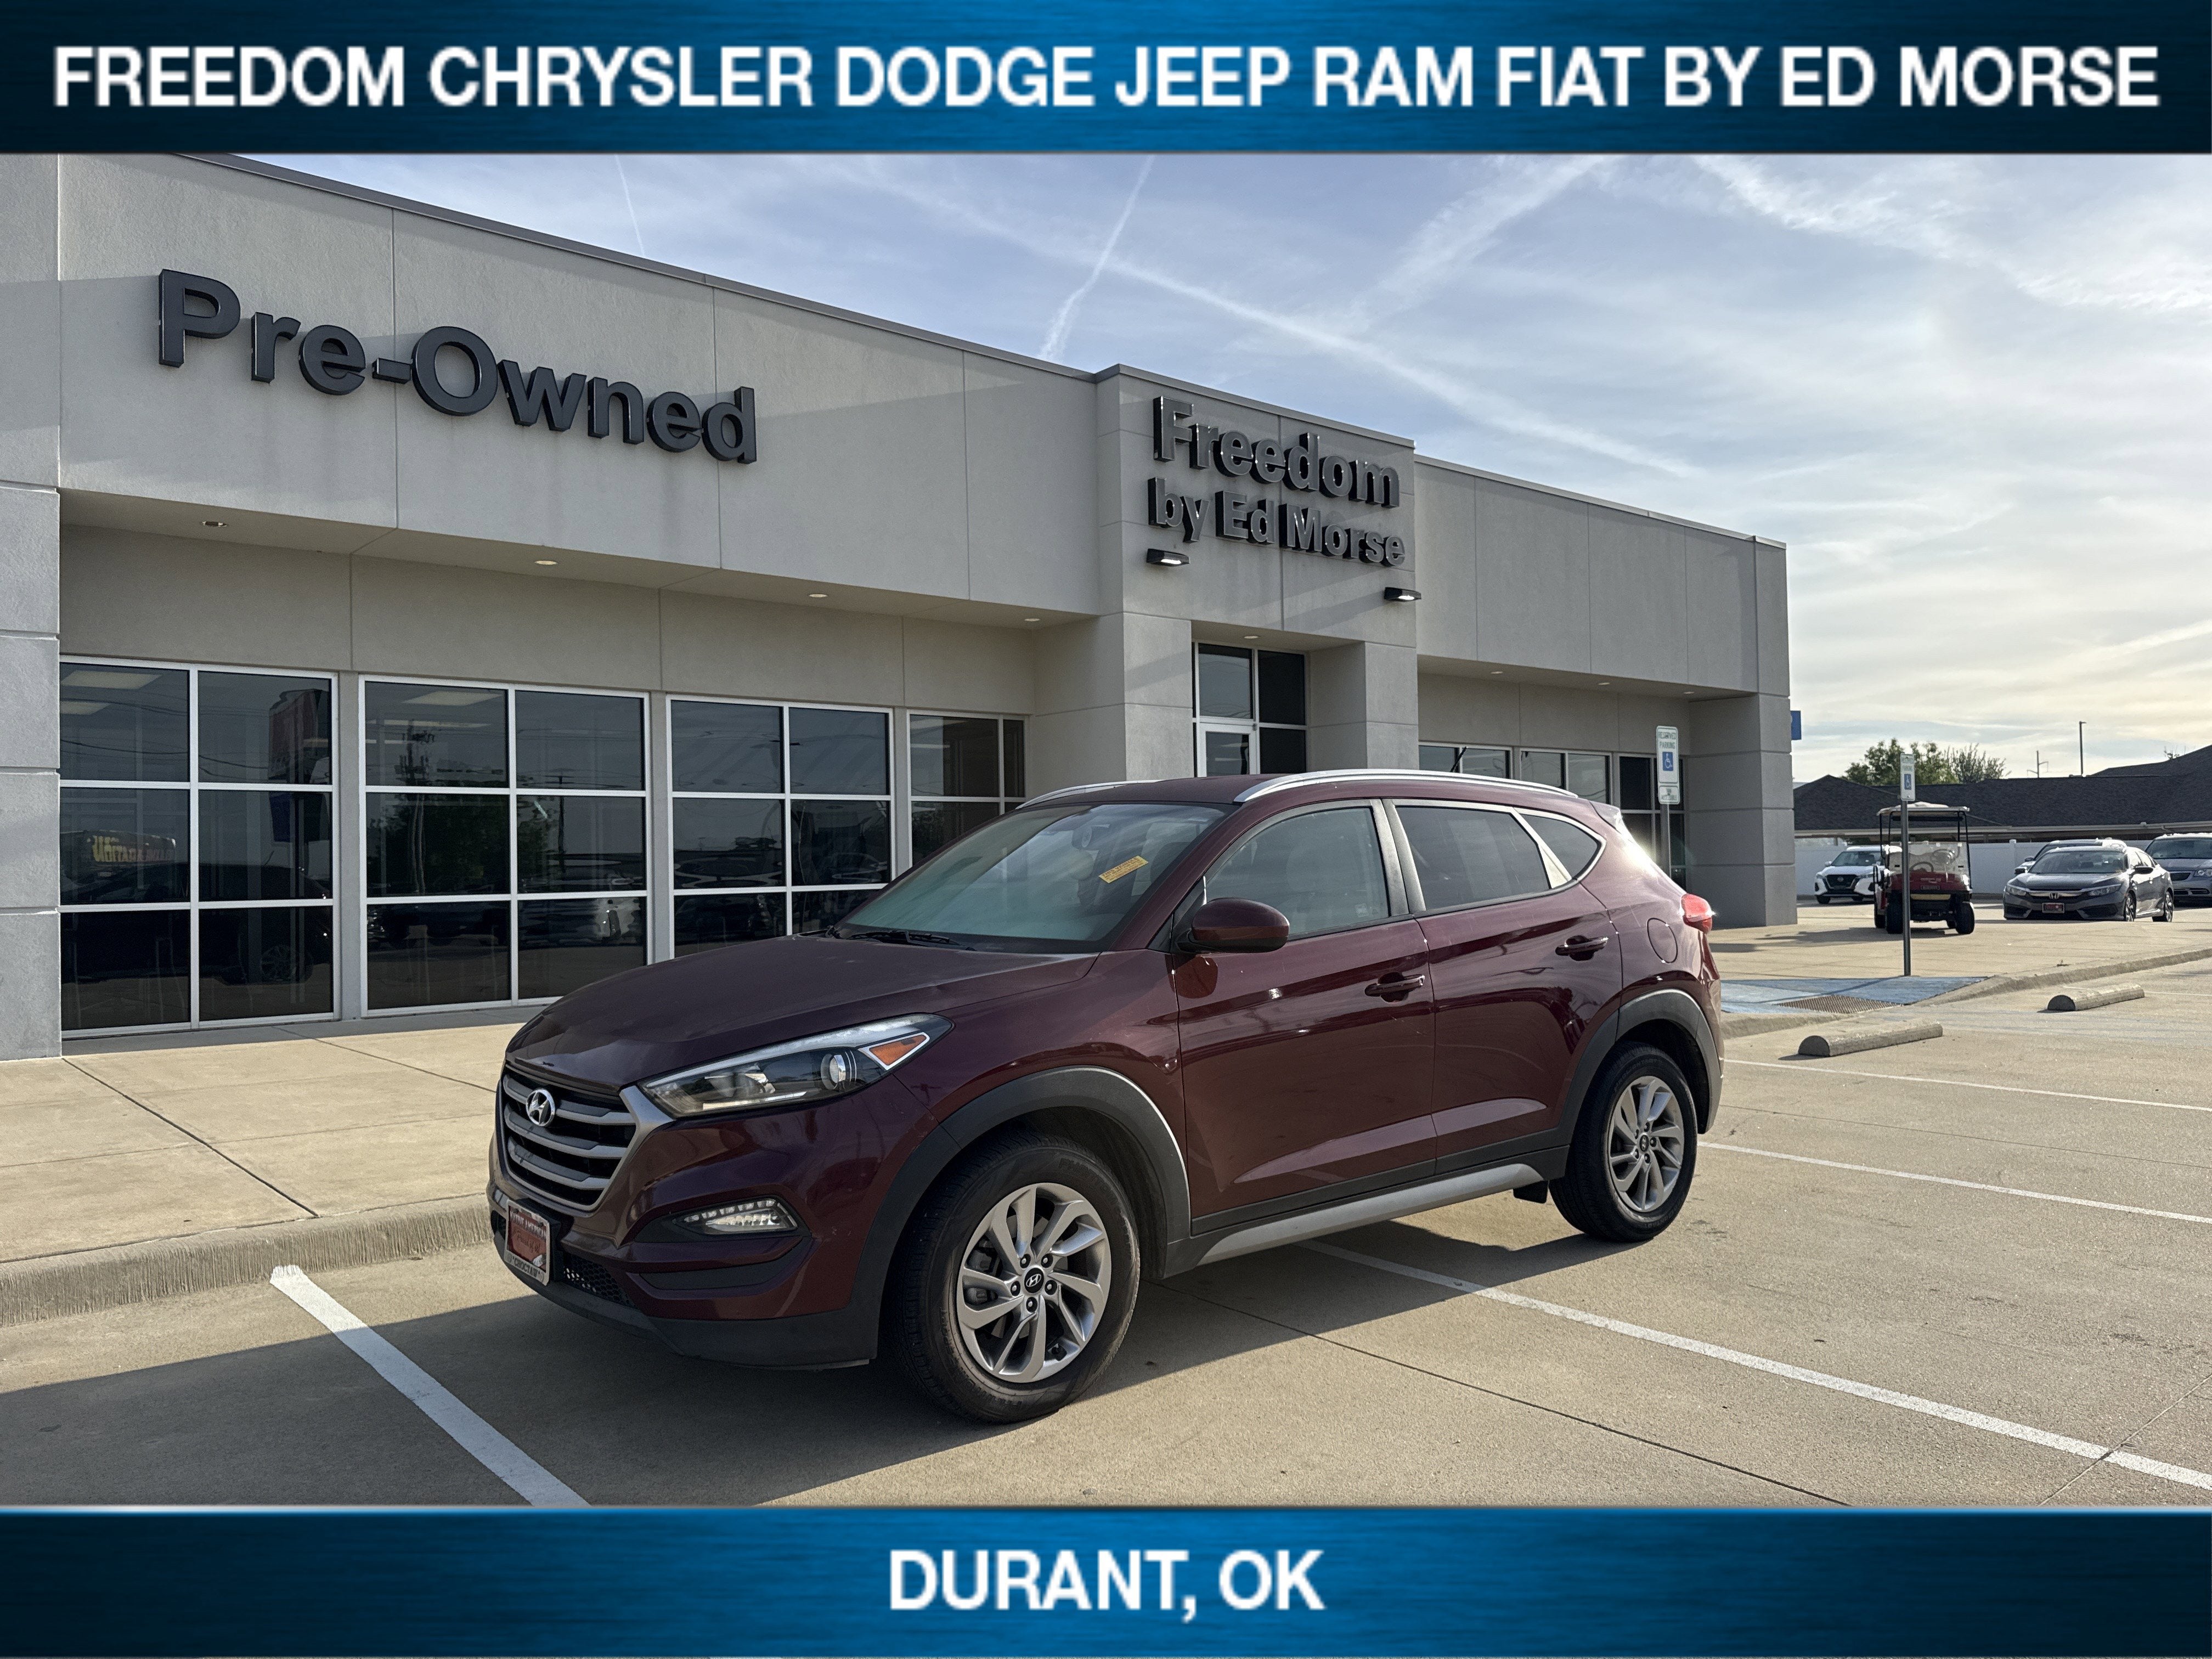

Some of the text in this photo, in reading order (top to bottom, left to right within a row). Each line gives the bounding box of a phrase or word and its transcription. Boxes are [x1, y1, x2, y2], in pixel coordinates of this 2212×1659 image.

[157, 268, 757, 466] Pre-Owned
[1153, 396, 1400, 509] Freedom
[1148, 477, 1406, 567] by Ed Morse
[1660, 741, 1675, 749] PARKING
[514, 1258, 539, 1278] CHOCTAW
